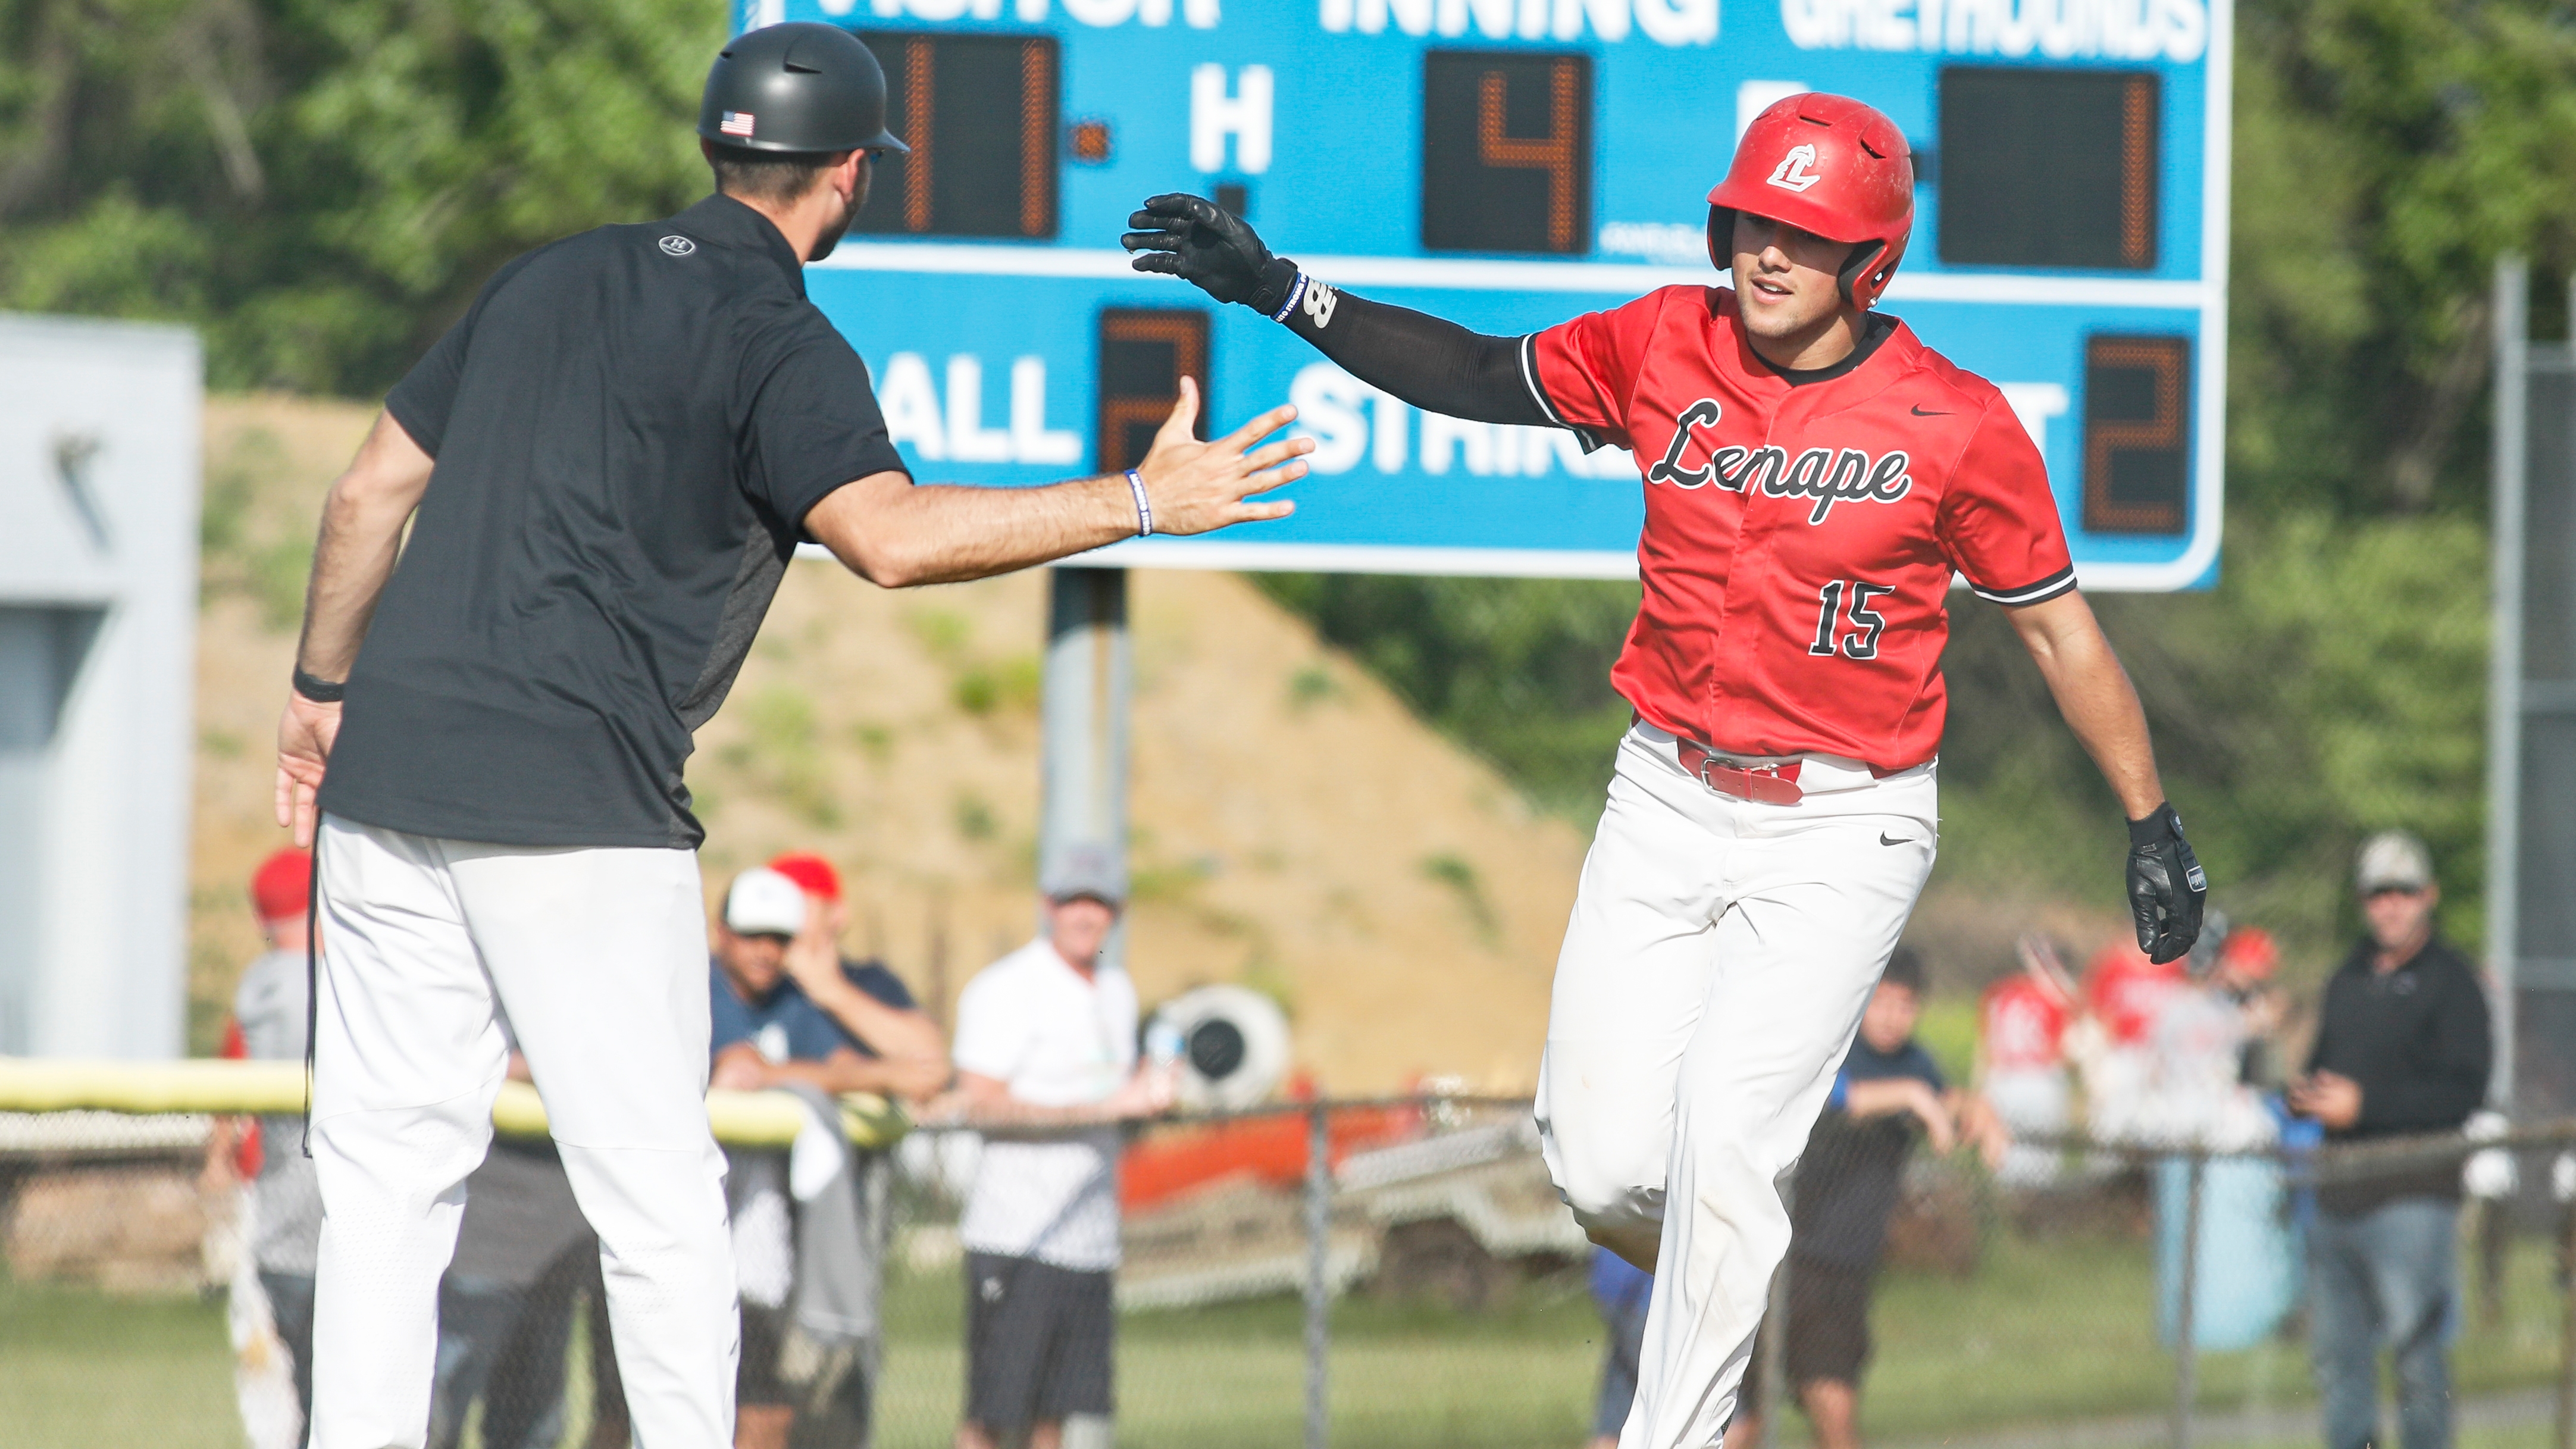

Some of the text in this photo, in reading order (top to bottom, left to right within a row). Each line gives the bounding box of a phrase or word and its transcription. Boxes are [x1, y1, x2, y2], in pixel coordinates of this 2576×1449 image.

[1190, 63, 1275, 174] H
[1478, 57, 1579, 252] 4
[2121, 77, 2154, 268] 1
[1285, 282, 1305, 312] STRONG
[878, 351, 1083, 464] ALL
[1647, 398, 1913, 525] Lenape
[2084, 342, 2180, 528] 2
[1809, 579, 1897, 660] 15
